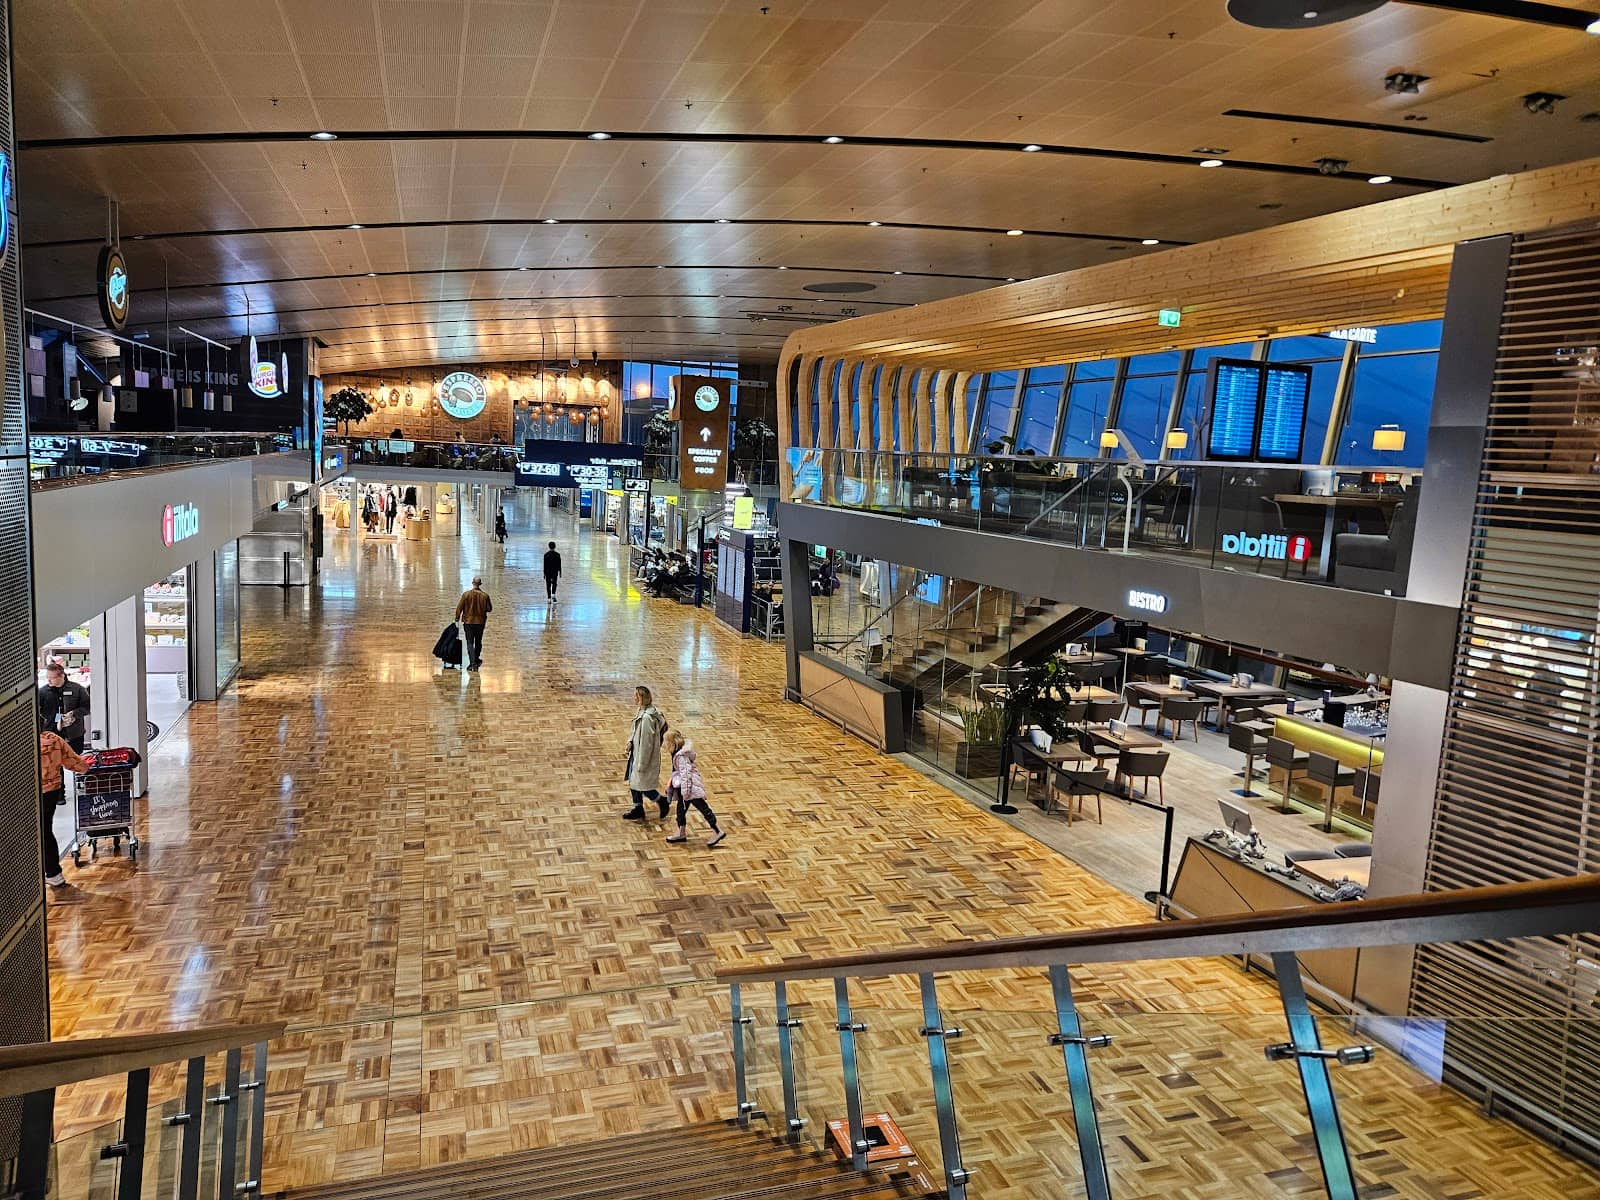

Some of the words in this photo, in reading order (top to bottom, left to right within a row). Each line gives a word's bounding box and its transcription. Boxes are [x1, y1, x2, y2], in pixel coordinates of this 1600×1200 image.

[188, 370, 202, 383] IS
[205, 372, 239, 385] KING
[442, 374, 484, 394] ESPRESSO
[687, 448, 722, 456] SPECIALTY
[531, 463, 559, 474] 37-60
[635, 480, 647, 489] 29
[1129, 590, 1166, 613] BISTRO
